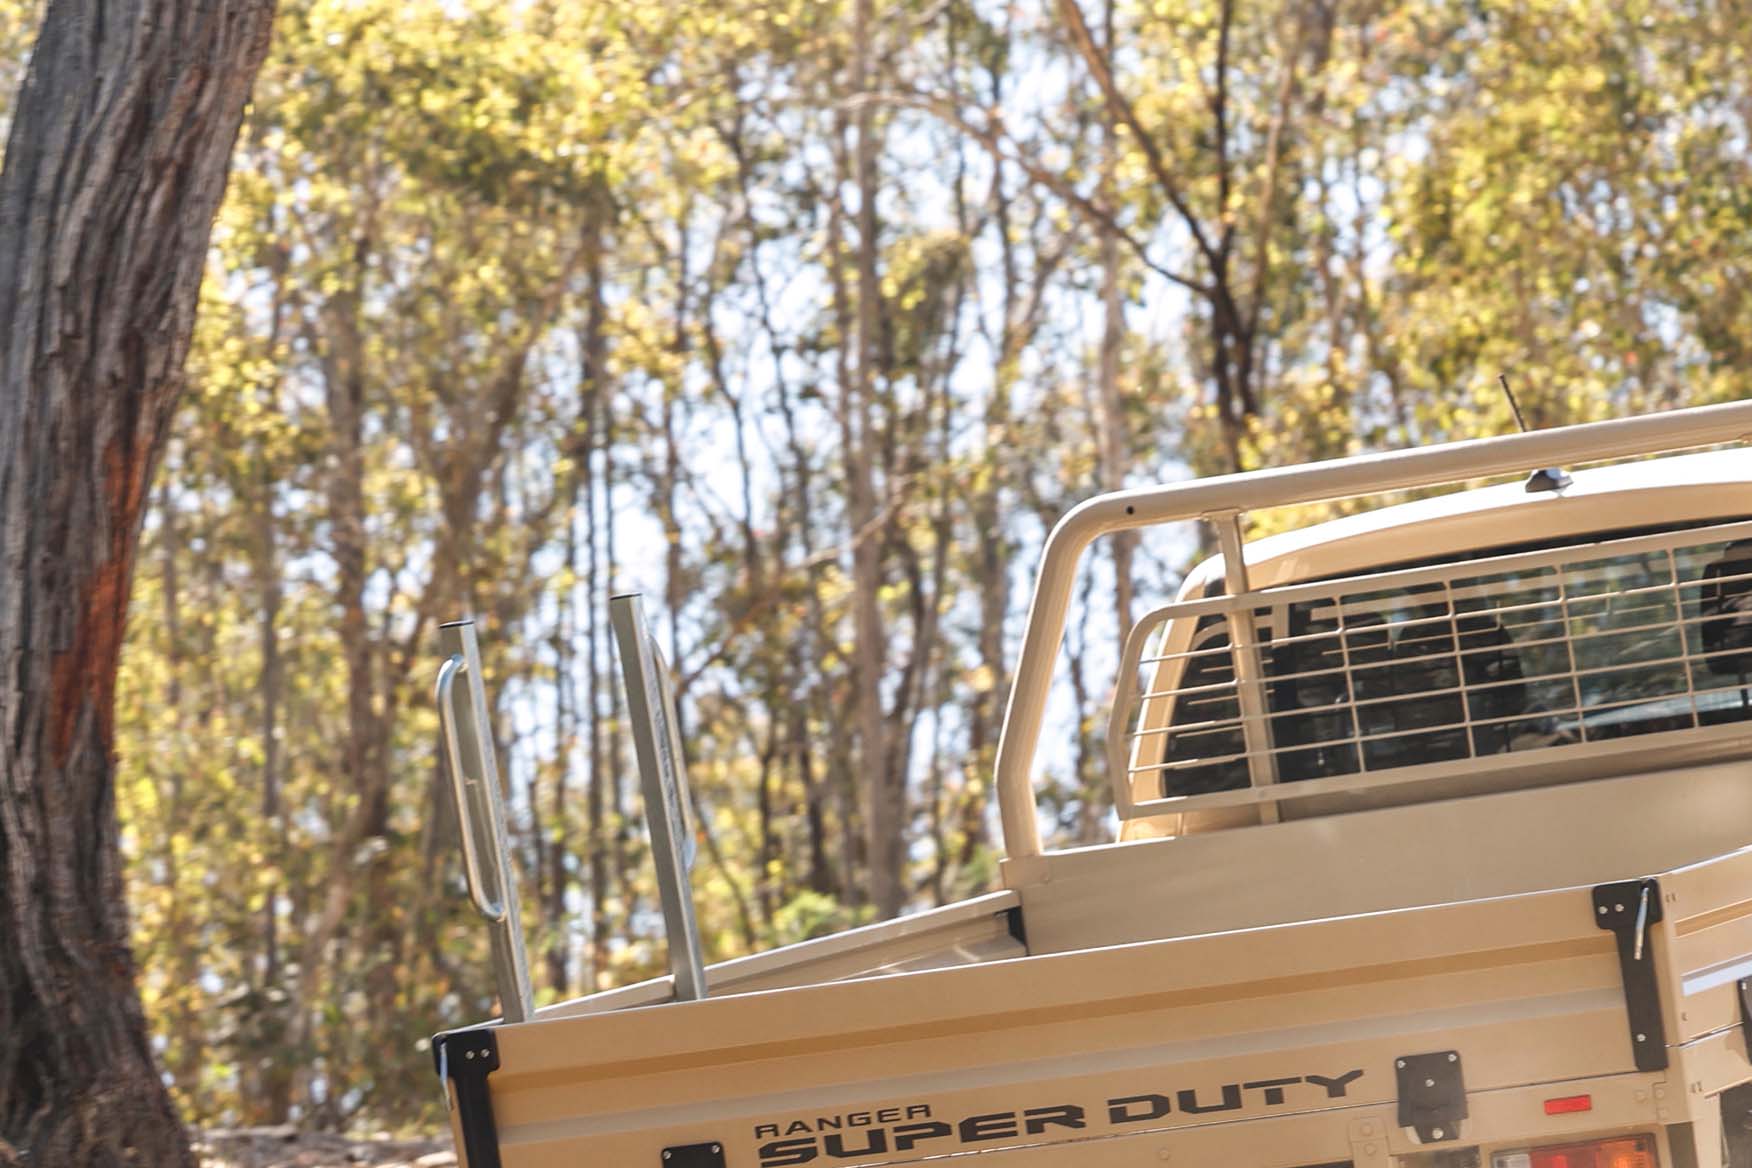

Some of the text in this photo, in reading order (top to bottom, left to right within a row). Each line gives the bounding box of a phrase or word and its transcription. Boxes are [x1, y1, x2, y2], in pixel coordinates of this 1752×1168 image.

[754, 1104, 932, 1139] RANGER
[758, 1069, 1364, 1168] SUPER DUTY
